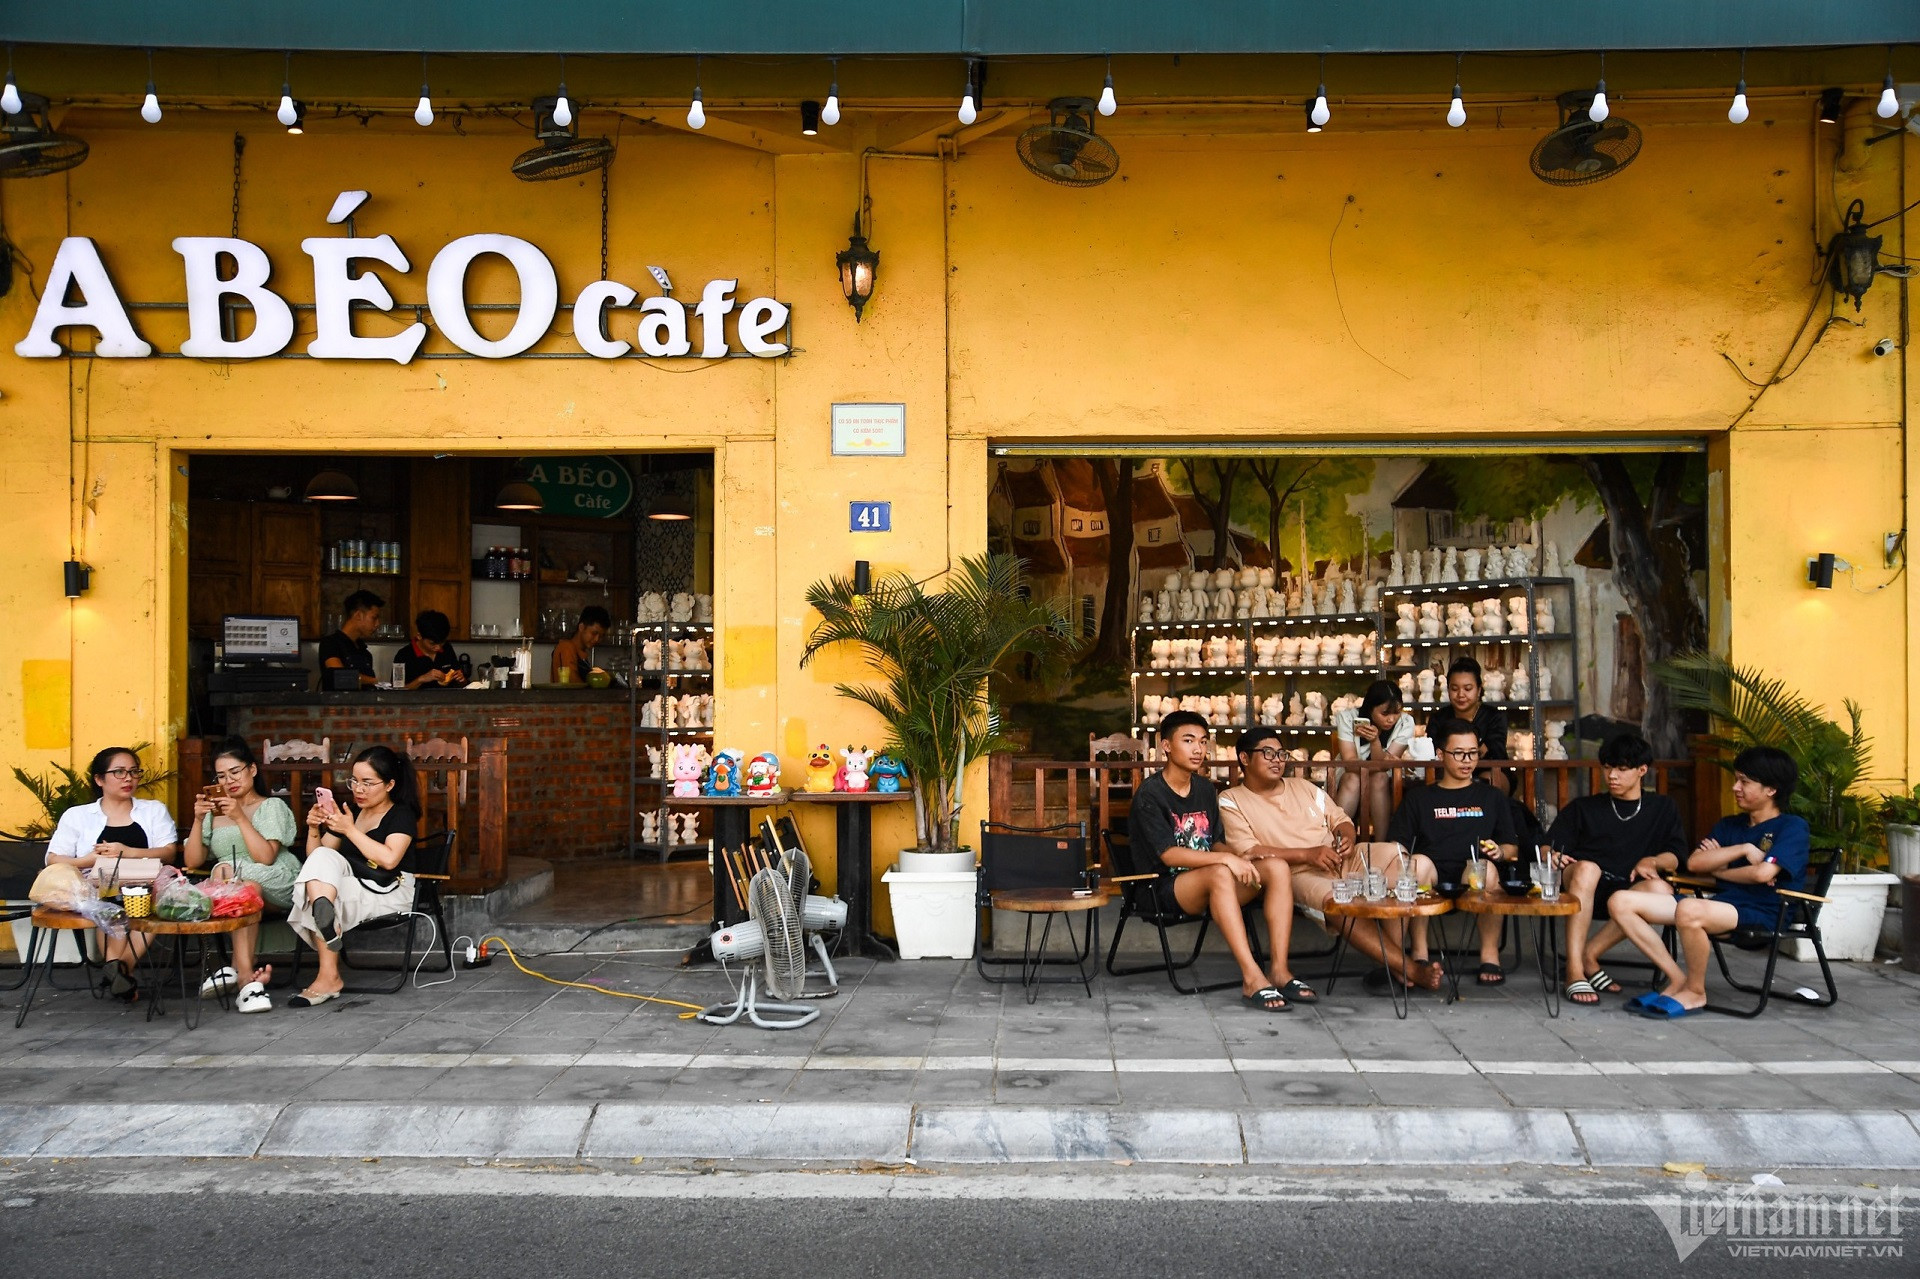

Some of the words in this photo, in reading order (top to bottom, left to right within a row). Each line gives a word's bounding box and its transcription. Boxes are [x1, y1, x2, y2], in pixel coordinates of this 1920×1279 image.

[14, 236, 154, 359] A
[172, 190, 559, 365] BÉO
[526, 463, 550, 484] A
[558, 462, 618, 489] BÉO
[574, 493, 612, 510] Càfe
[857, 506, 881, 528] 41
